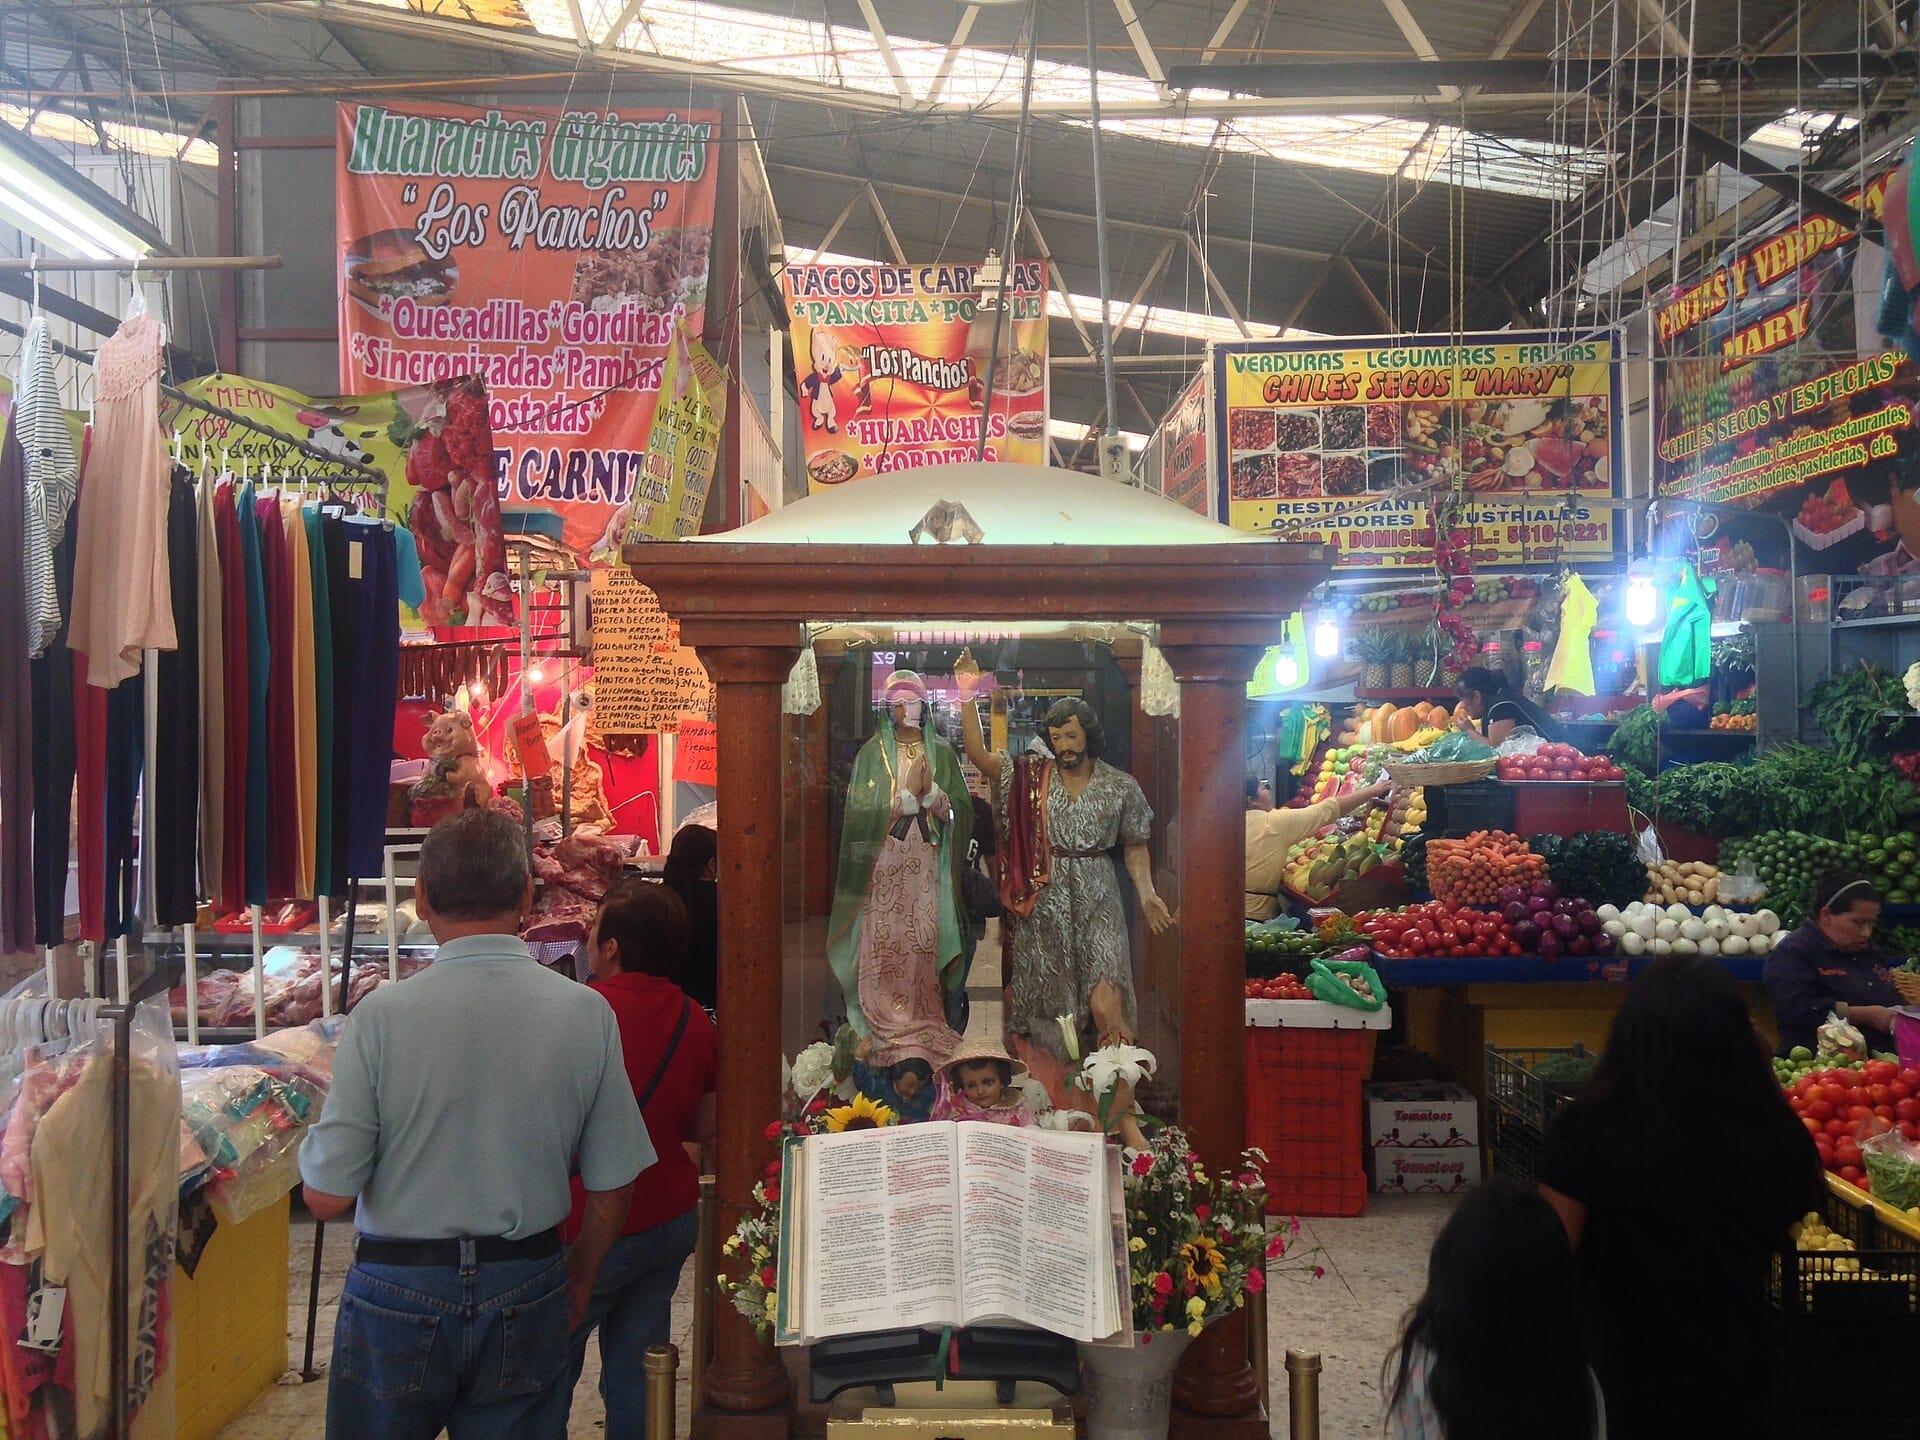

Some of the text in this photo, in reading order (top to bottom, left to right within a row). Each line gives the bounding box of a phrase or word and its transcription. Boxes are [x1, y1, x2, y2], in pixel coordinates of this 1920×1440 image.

[349, 105, 709, 189] Huaraches Gigantes
[787, 263, 1042, 297] TACOS DE CARAS
[1731, 259, 1748, 299] Y
[931, 297, 1042, 323] POLE
[1723, 301, 1809, 368] MARY
[901, 349, 969, 390] Panchos
[1233, 343, 1597, 373] VERDURAS LEGUMBRES FRUTAS
[1263, 371, 1362, 403] CHILES
[1366, 368, 1452, 399] SECOS
[847, 414, 1006, 446] HUARACHS
[1718, 401, 1770, 440] SECOS
[1773, 392, 1787, 420] Y
[1731, 449, 1774, 476] domicilio:
[1871, 435, 1896, 459] etc.
[494, 449, 512, 500] E
[518, 449, 645, 503] CARNIT
[1393, 1109, 1453, 1122] Tomatoes
[1392, 1157, 1465, 1174] Tomatoes
